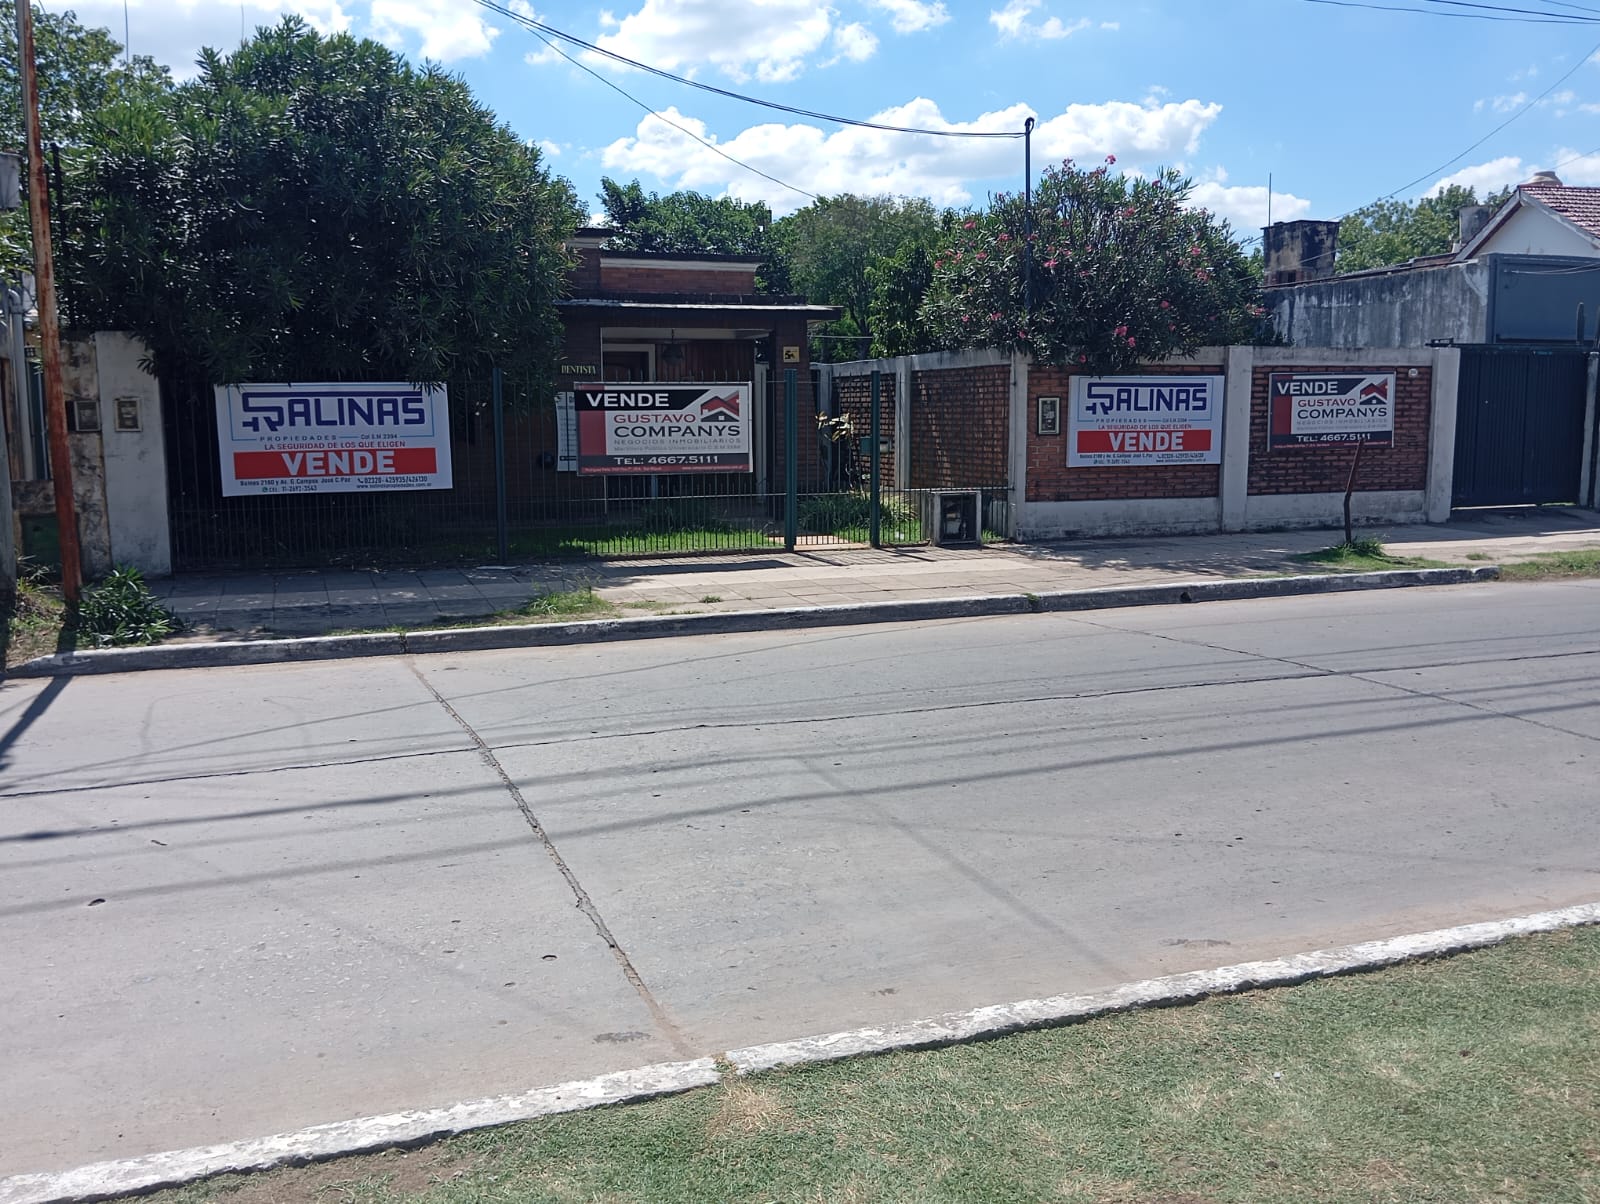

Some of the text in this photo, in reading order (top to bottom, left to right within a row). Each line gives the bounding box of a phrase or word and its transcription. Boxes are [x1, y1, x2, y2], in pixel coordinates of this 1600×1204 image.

[561, 365, 596, 374] DENTISTA
[1277, 381, 1338, 395] VENDE
[586, 393, 669, 408] VENDE
[1086, 382, 1207, 415] SALINAS
[1297, 398, 1357, 408] GUSTAVO
[242, 391, 425, 432] SALINAS
[1297, 407, 1387, 420] COMPANYS
[614, 414, 696, 425] GUSTAVO
[614, 425, 741, 438] COMPANYS
[277, 442, 325, 450] SEGURIDAD
[378, 440, 405, 448] ELIGEN
[1109, 431, 1184, 452] VENDE
[281, 450, 395, 477] VENDE
[647, 456, 718, 465] 4667.5111
